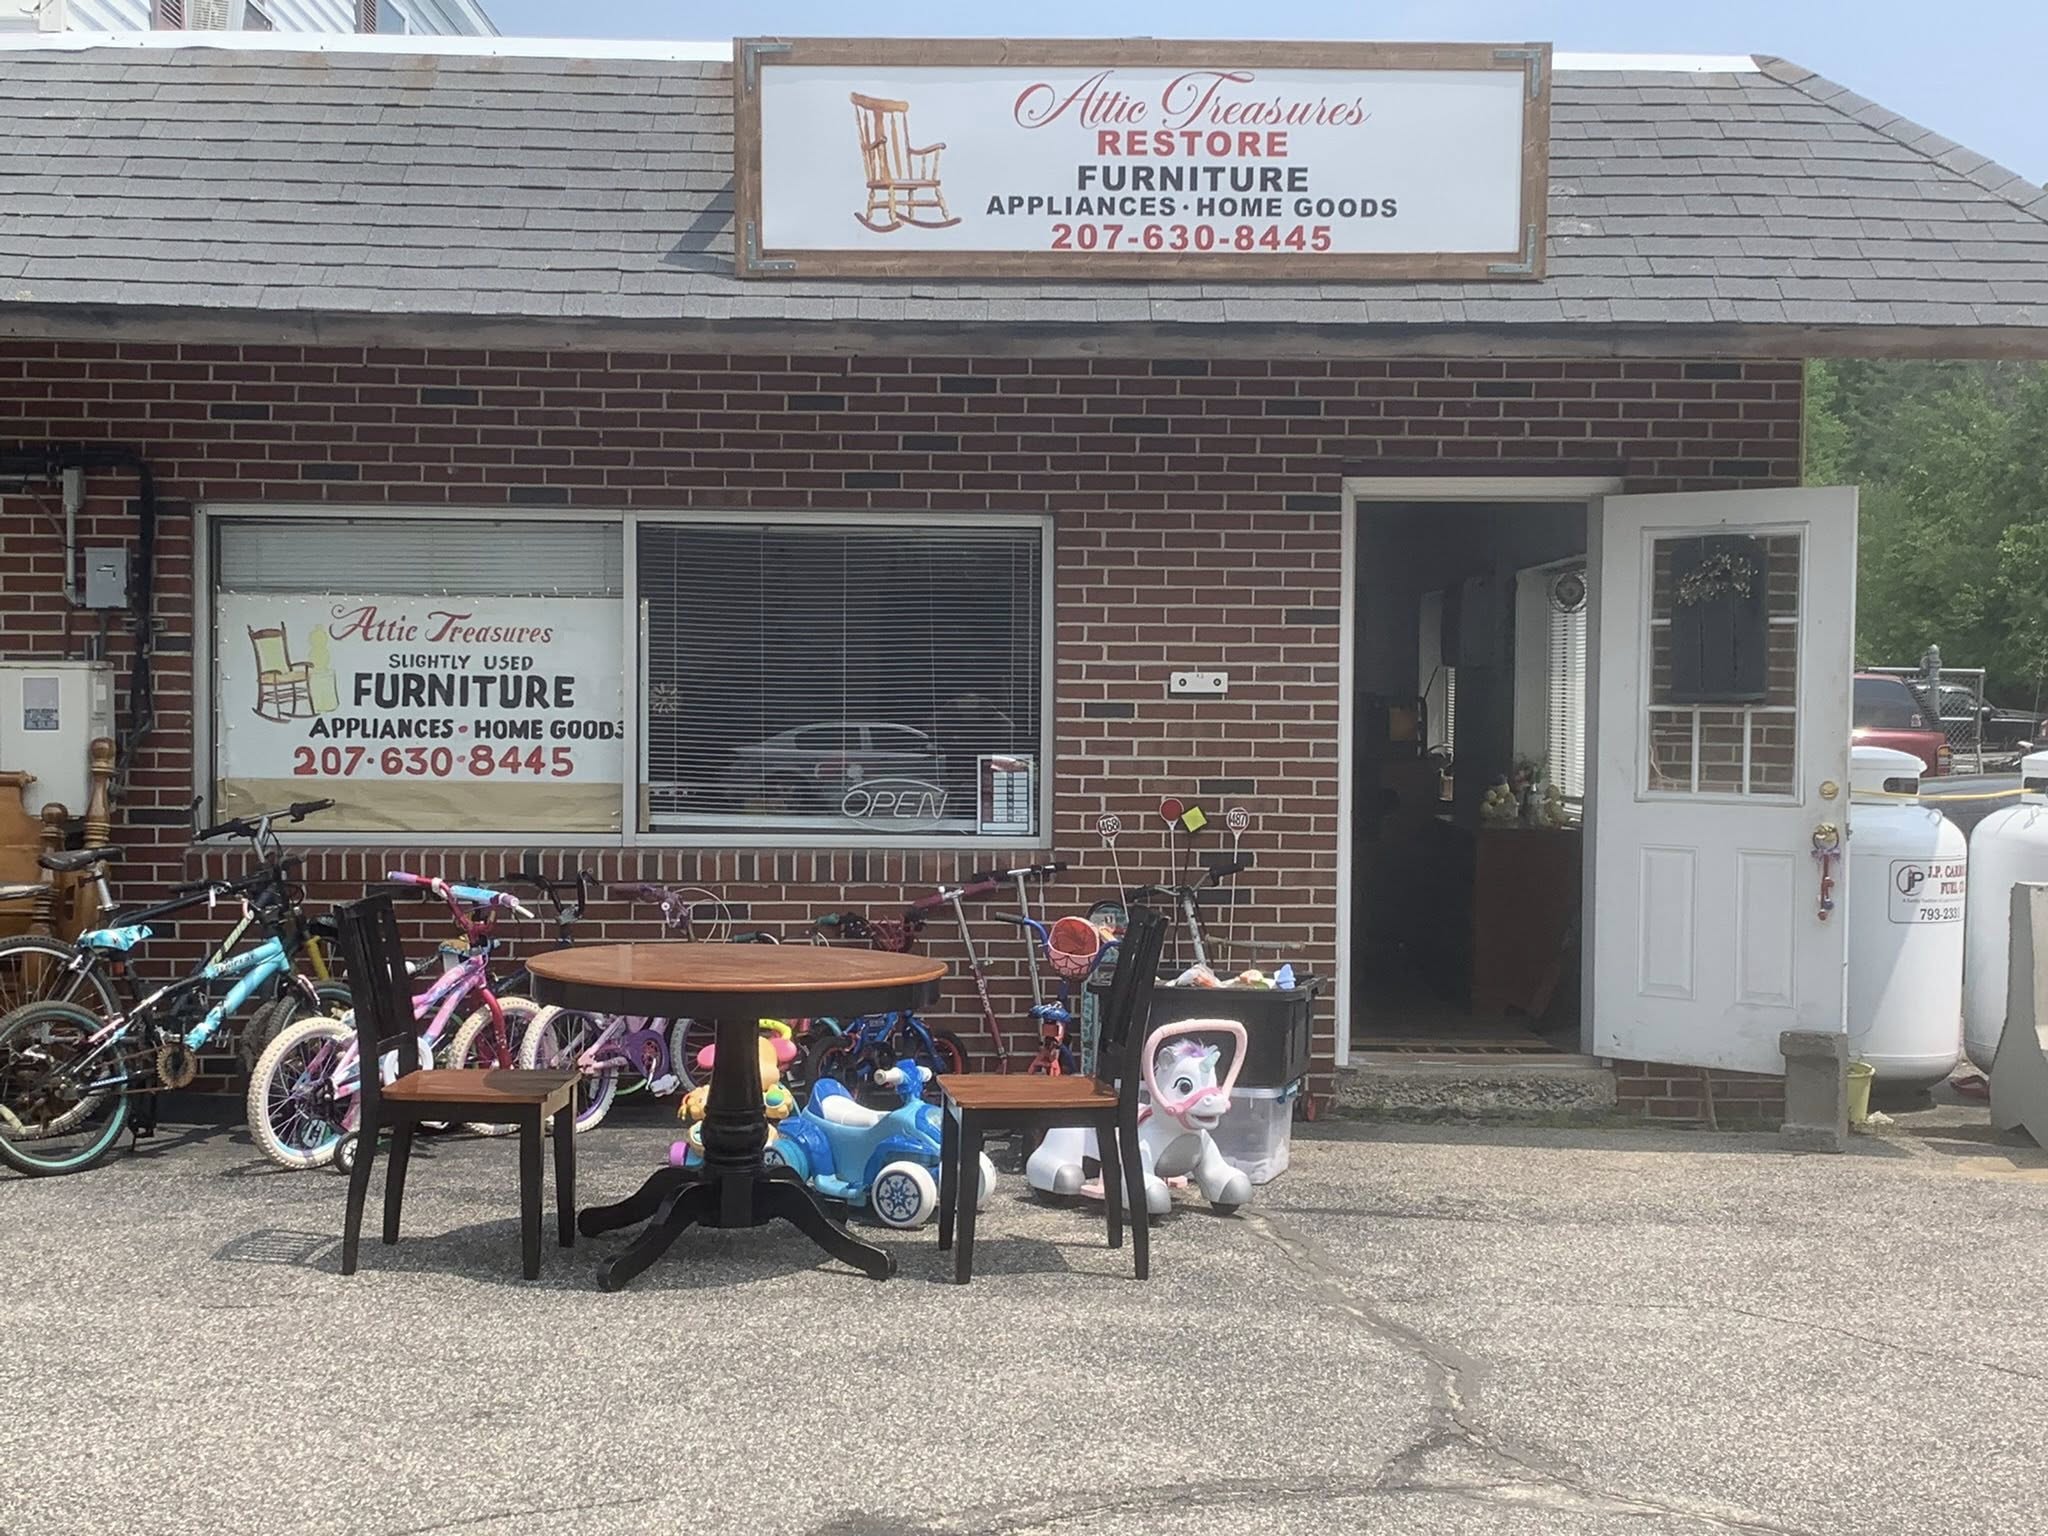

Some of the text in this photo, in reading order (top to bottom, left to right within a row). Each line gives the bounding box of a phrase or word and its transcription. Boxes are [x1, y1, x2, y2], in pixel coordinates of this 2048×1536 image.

[1014, 70, 1371, 129] Attic Treasures
[1097, 131, 1288, 157] RESTORE
[1077, 165, 1309, 193] FURNITURE
[985, 195, 1398, 218] APPLIANCES HOME GOODS
[1050, 223, 1333, 253] 207-630-8445
[328, 604, 554, 644] Attic Treasures
[388, 653, 534, 671] SLIGHTLY USED
[353, 672, 575, 709] FURNITURE
[308, 718, 455, 741] APPLIANCES
[474, 719, 543, 741] HOME
[841, 789, 949, 820] OPEN
